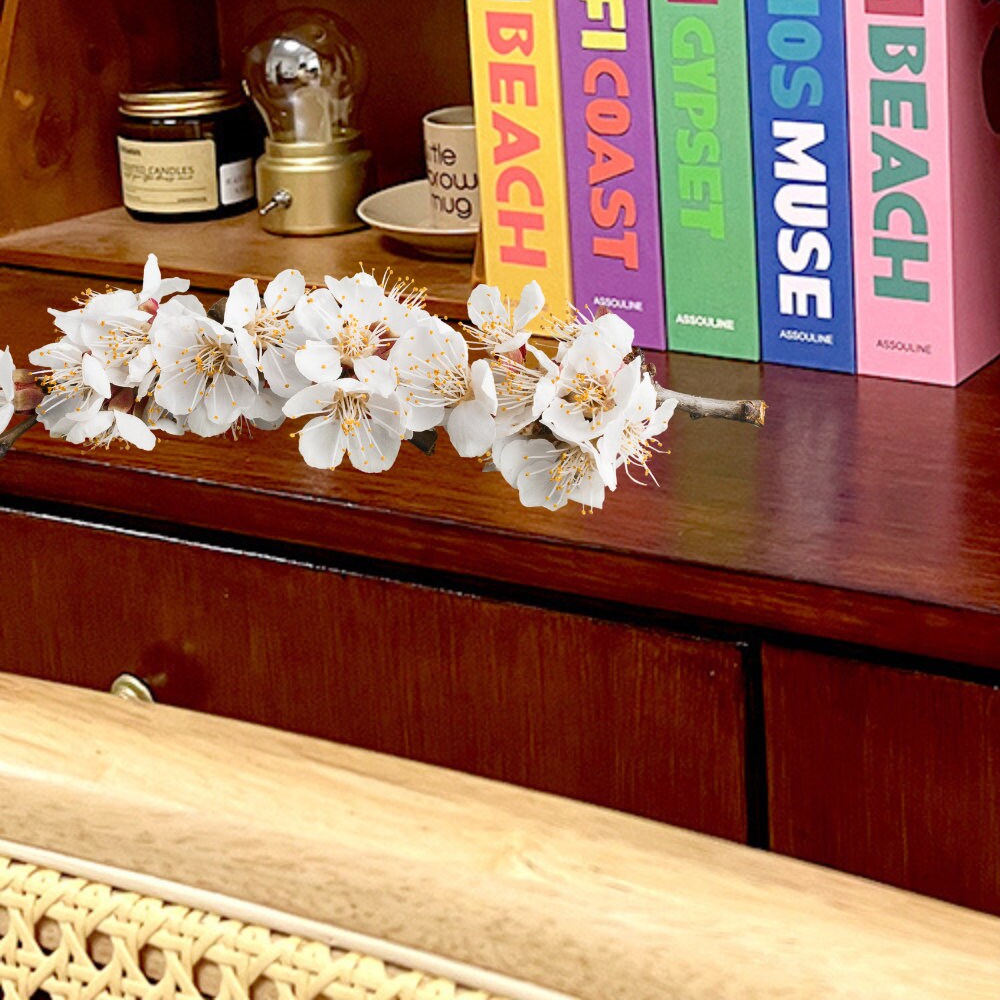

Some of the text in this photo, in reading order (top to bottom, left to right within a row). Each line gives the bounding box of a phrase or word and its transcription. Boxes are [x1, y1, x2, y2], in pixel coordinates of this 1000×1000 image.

[148, 166, 194, 175] CANDLES
[485, 10, 548, 269] BEACH
[583, 58, 639, 271] COAST
[671, 15, 727, 241] GYPSET
[867, 24, 930, 303] BEACH
[771, 120, 833, 320] MUSE
[593, 296, 643, 312] ASSOULINE
[675, 313, 735, 331] ASSOULINE
[779, 328, 834, 345] ASSOULINE
[876, 339, 932, 355] ASSOULINE
